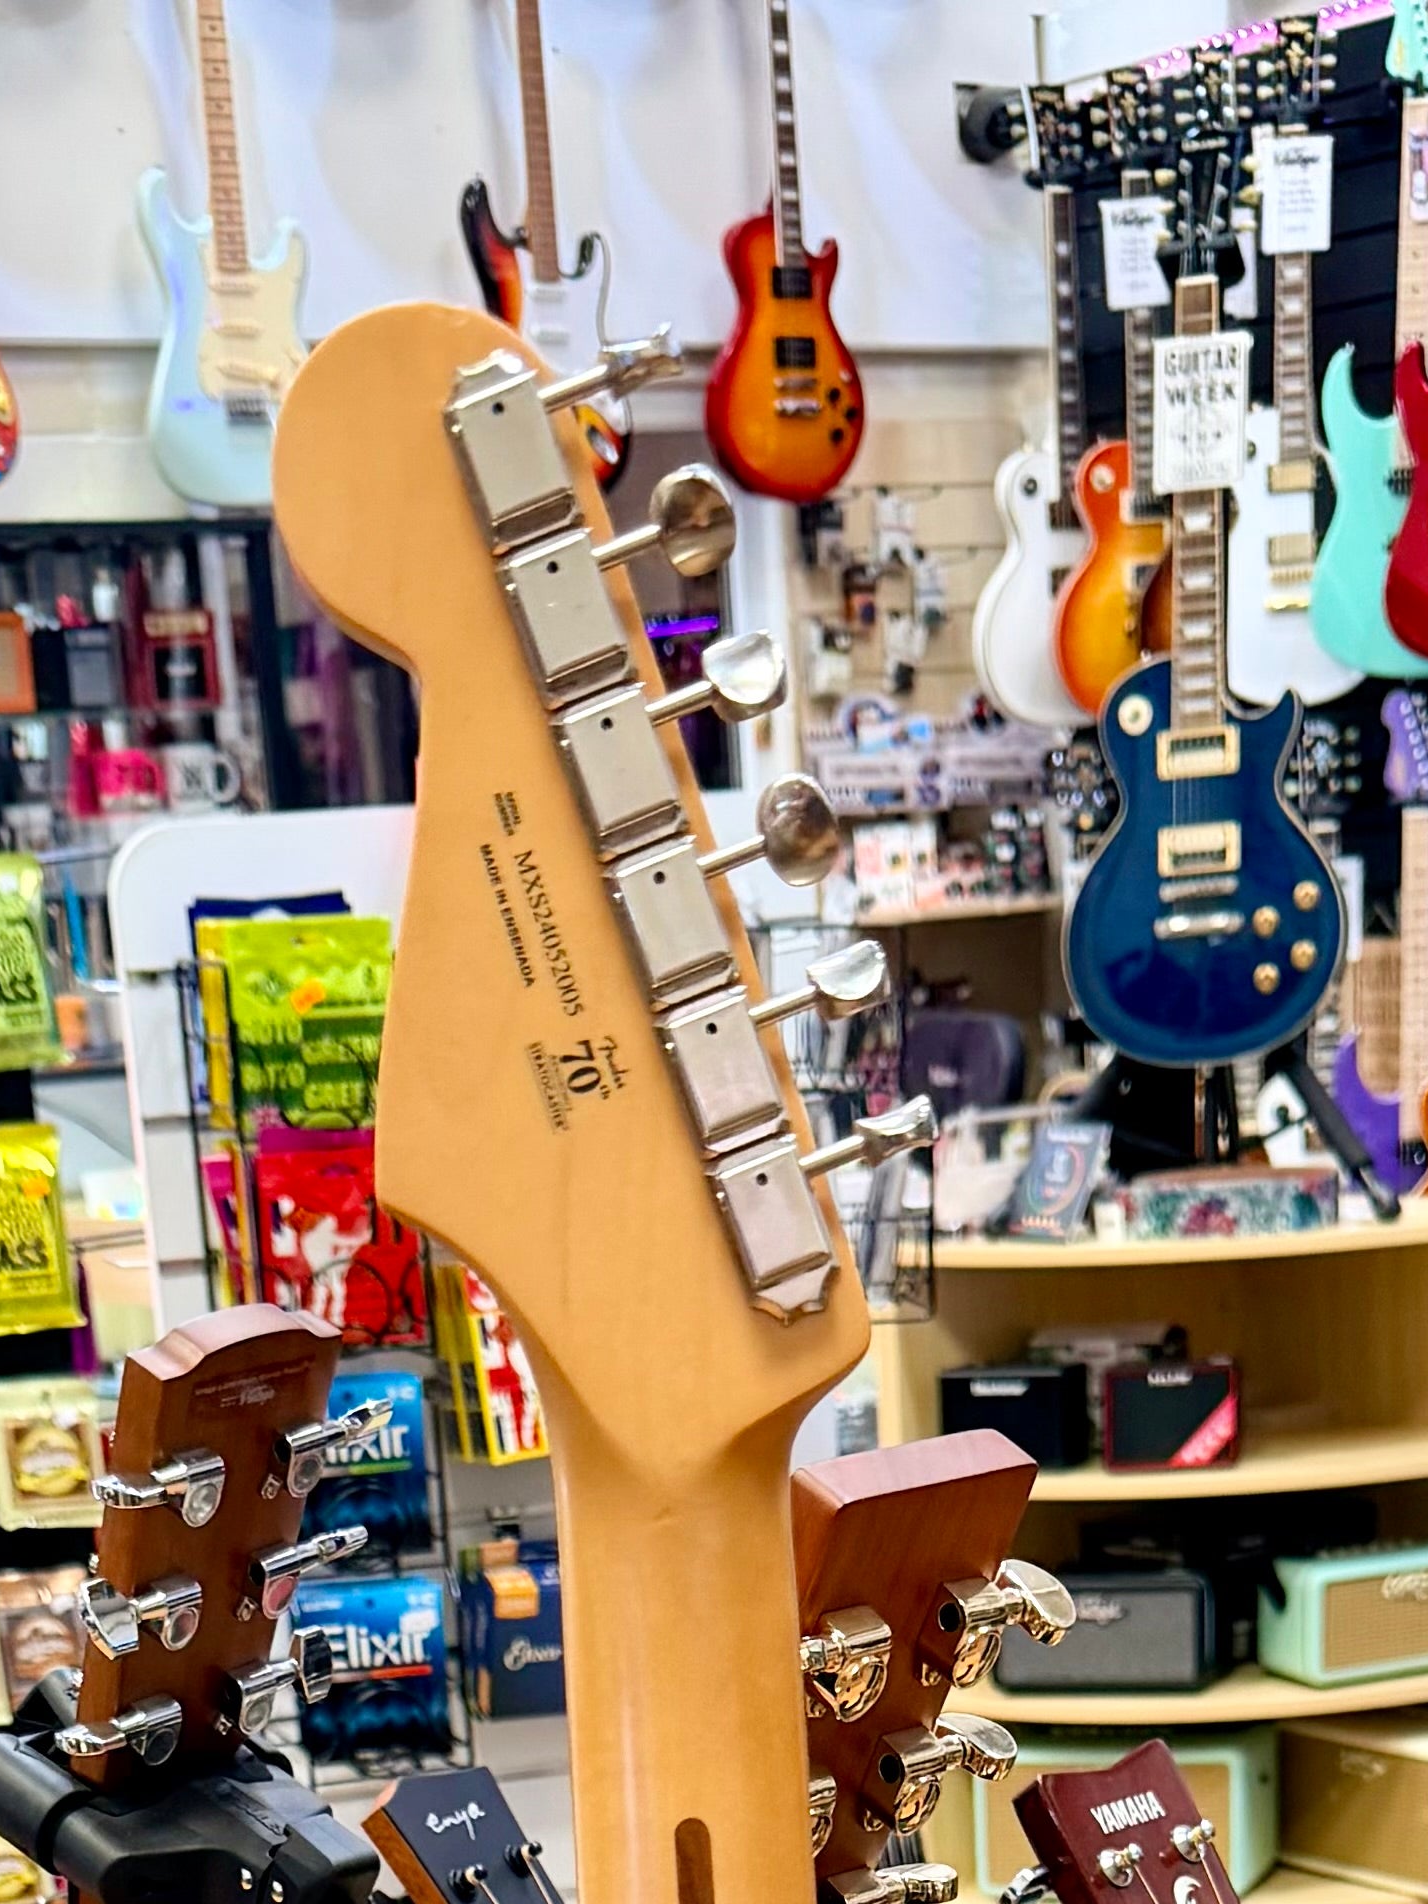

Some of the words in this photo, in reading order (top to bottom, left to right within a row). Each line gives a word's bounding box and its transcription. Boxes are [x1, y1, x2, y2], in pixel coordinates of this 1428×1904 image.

[479, 843, 502, 887] MADE
[495, 887, 508, 905] IN
[500, 906, 536, 989] ENSENADA
[514, 849, 586, 1018] MXS24052005
[324, 1424, 410, 1463] lixir
[424, 1801, 486, 1841] enya
[1090, 1791, 1166, 1834] YAMAHA
